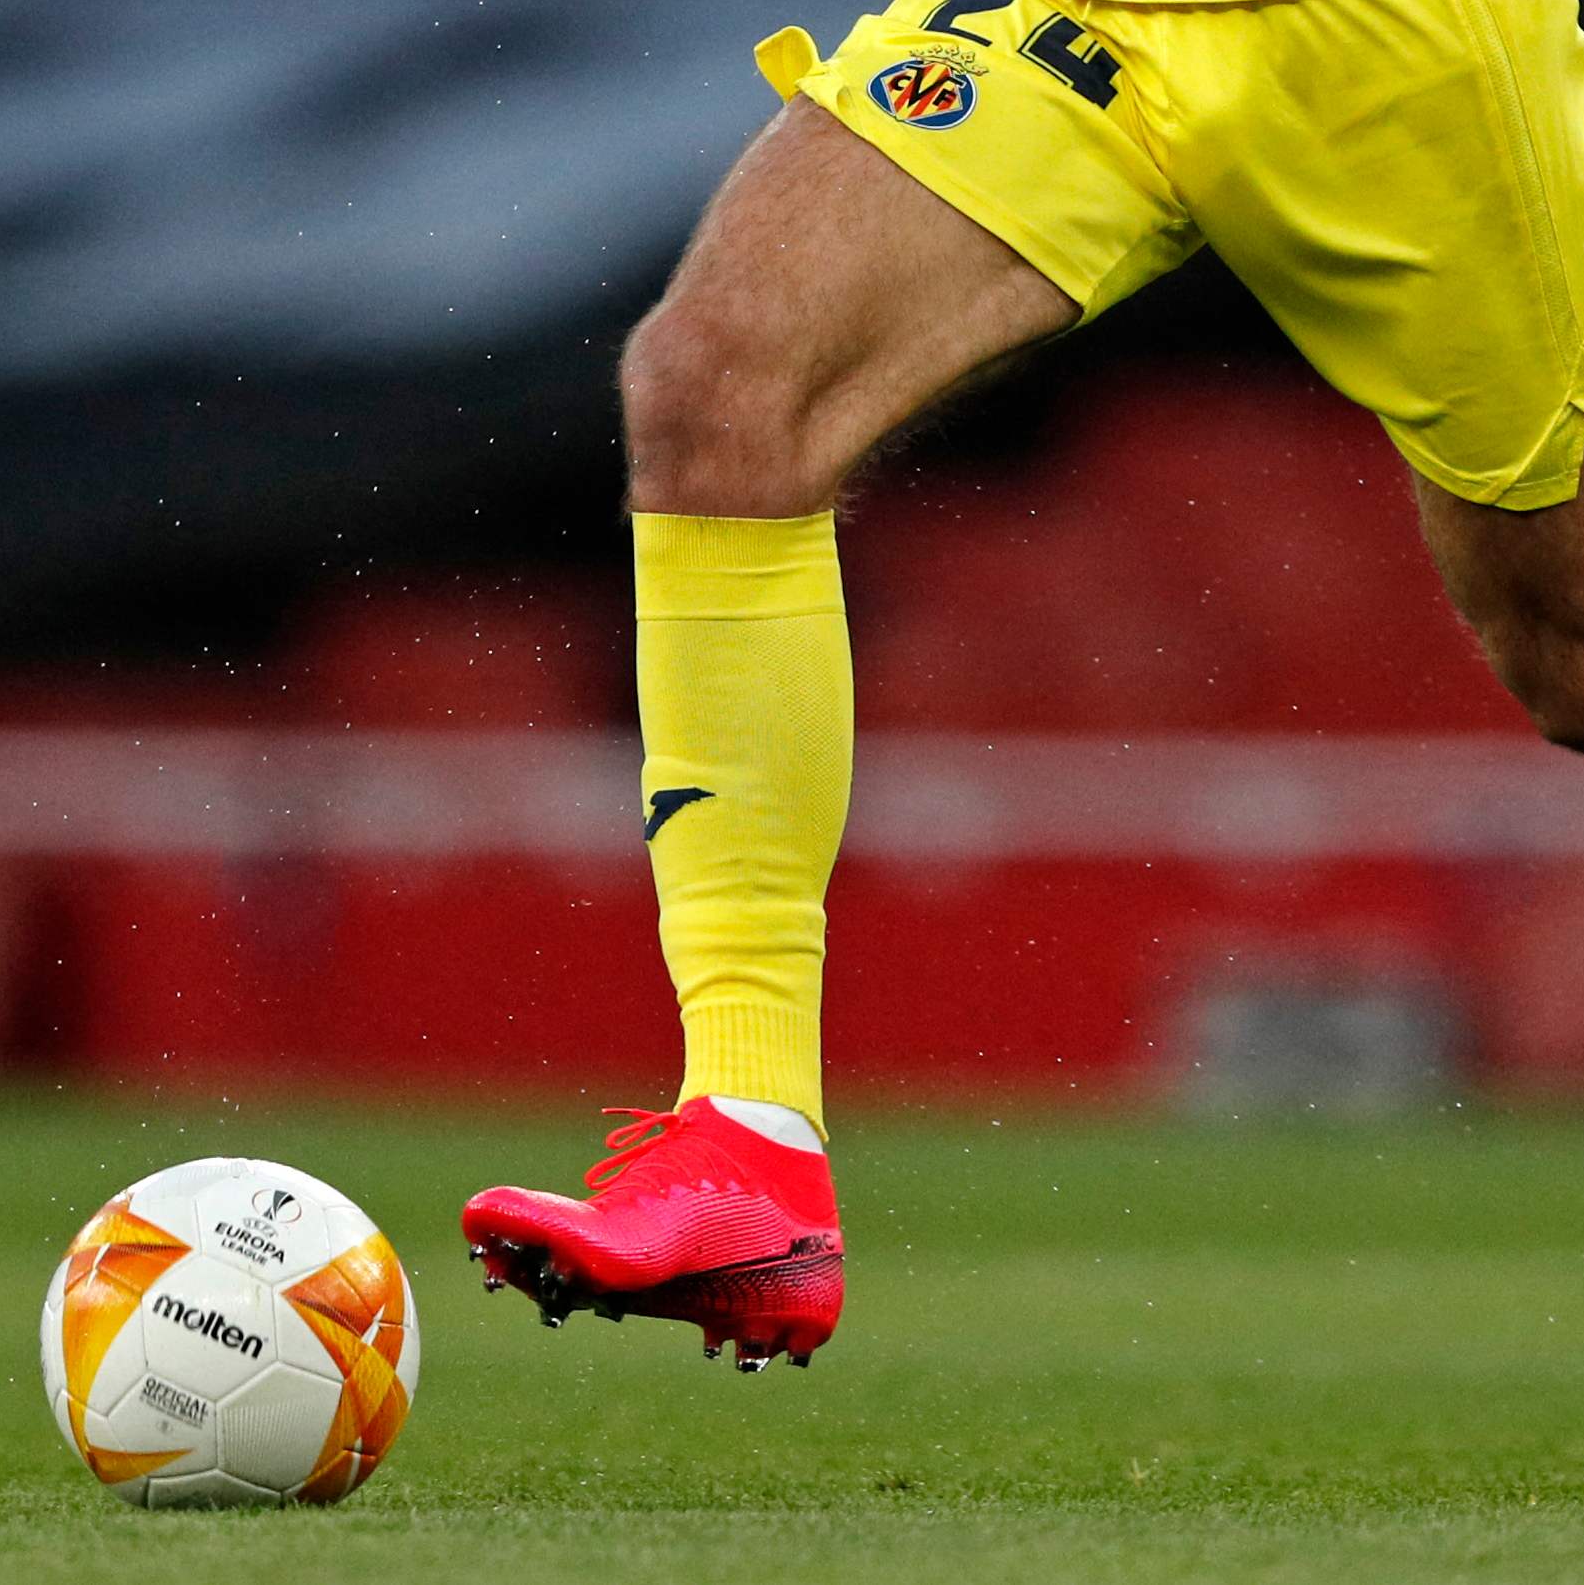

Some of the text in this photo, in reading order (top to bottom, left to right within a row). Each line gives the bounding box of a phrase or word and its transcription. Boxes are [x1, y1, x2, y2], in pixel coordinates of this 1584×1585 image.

[215, 1221, 285, 1264] EUROPA
[221, 1238, 268, 1266] LEAGUE
[153, 1295, 263, 1359] molten
